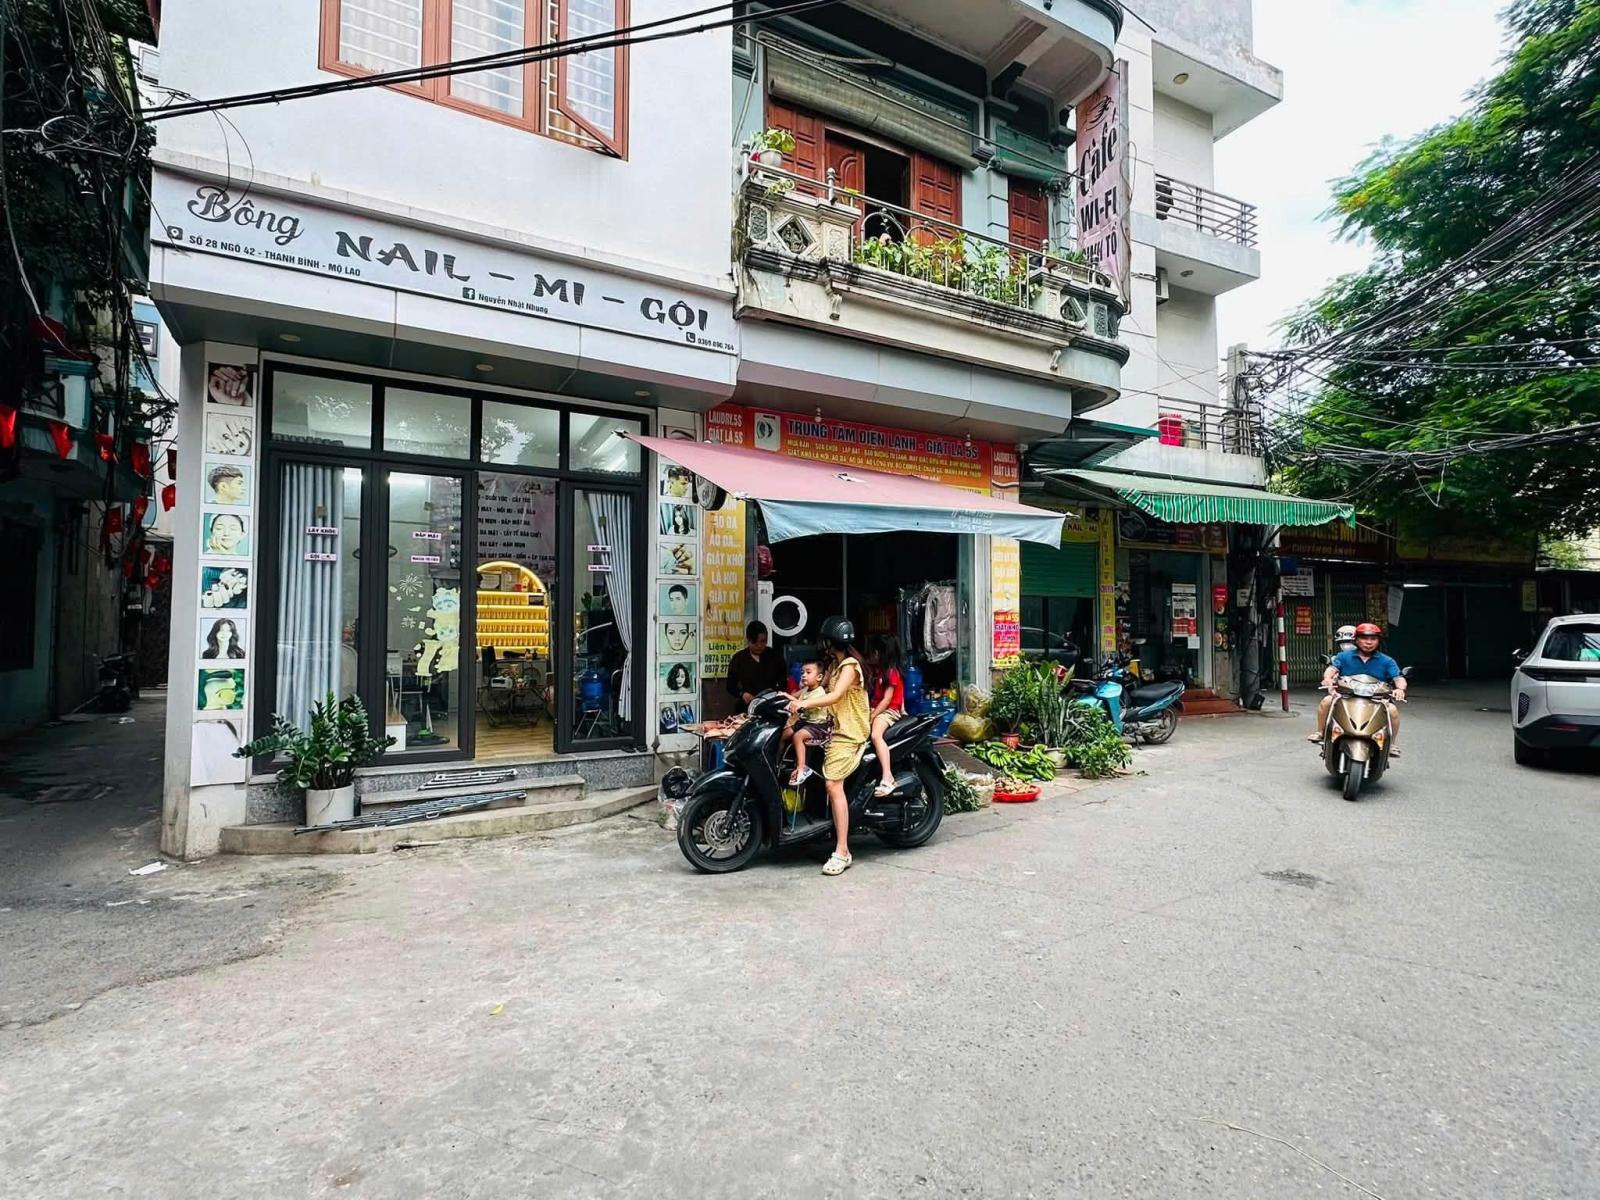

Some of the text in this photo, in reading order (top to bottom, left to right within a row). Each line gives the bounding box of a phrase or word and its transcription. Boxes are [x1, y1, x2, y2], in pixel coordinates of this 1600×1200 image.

[187, 184, 305, 246] Bông
[1080, 186, 1117, 233] WI-FI
[205, 238, 218, 249] 28
[244, 246, 256, 256] 42
[264, 250, 295, 264] THANH
[345, 266, 361, 277] LAO
[335, 231, 471, 282] NAIL
[533, 273, 585, 306] MI
[640, 297, 708, 331] GỘI
[526, 302, 549, 314] Nhung
[734, 431, 744, 444] 5S
[788, 420, 829, 440] TRUNG
[831, 423, 857, 443] TÂM
[887, 432, 917, 453] LẠNH
[709, 642, 725, 650] Liên
